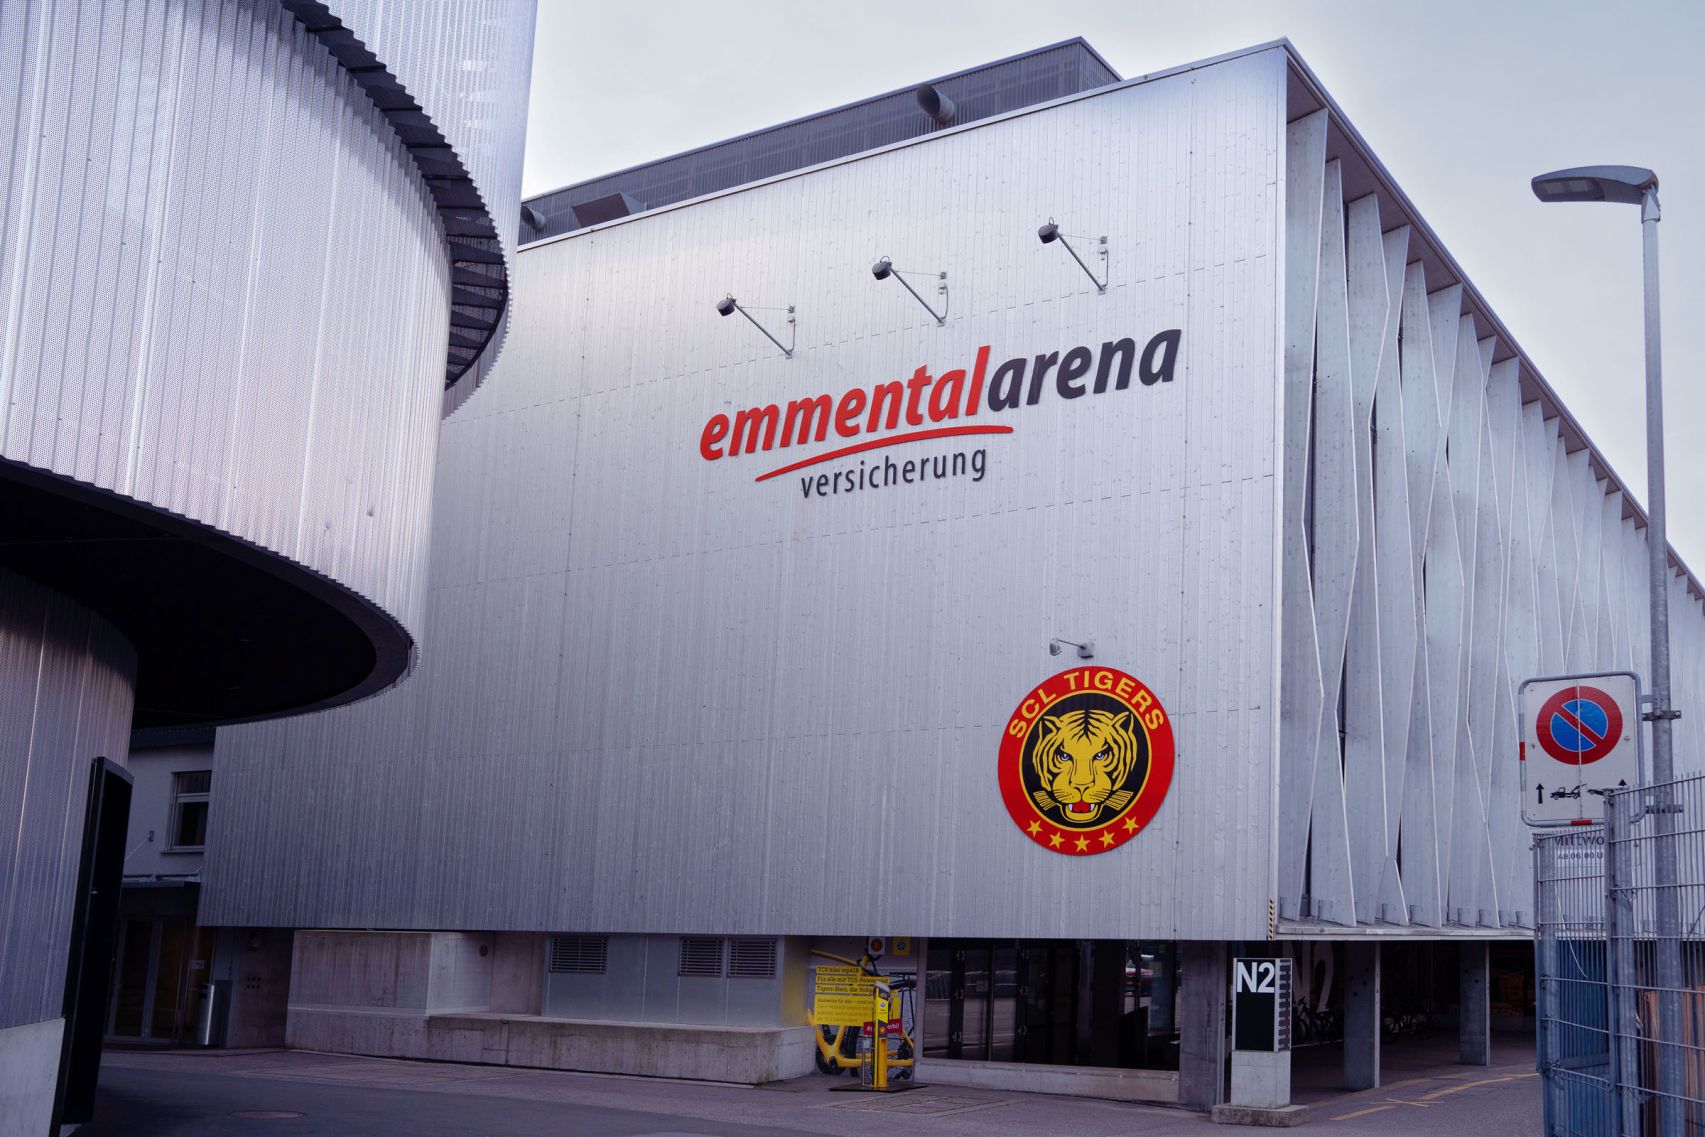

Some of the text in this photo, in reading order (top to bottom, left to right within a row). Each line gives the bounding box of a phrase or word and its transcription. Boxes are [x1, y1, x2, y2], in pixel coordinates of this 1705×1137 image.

[801, 448, 987, 499] versicherung
[1008, 670, 1165, 739] SCL TIGERS
[1236, 961, 1276, 994] N2
